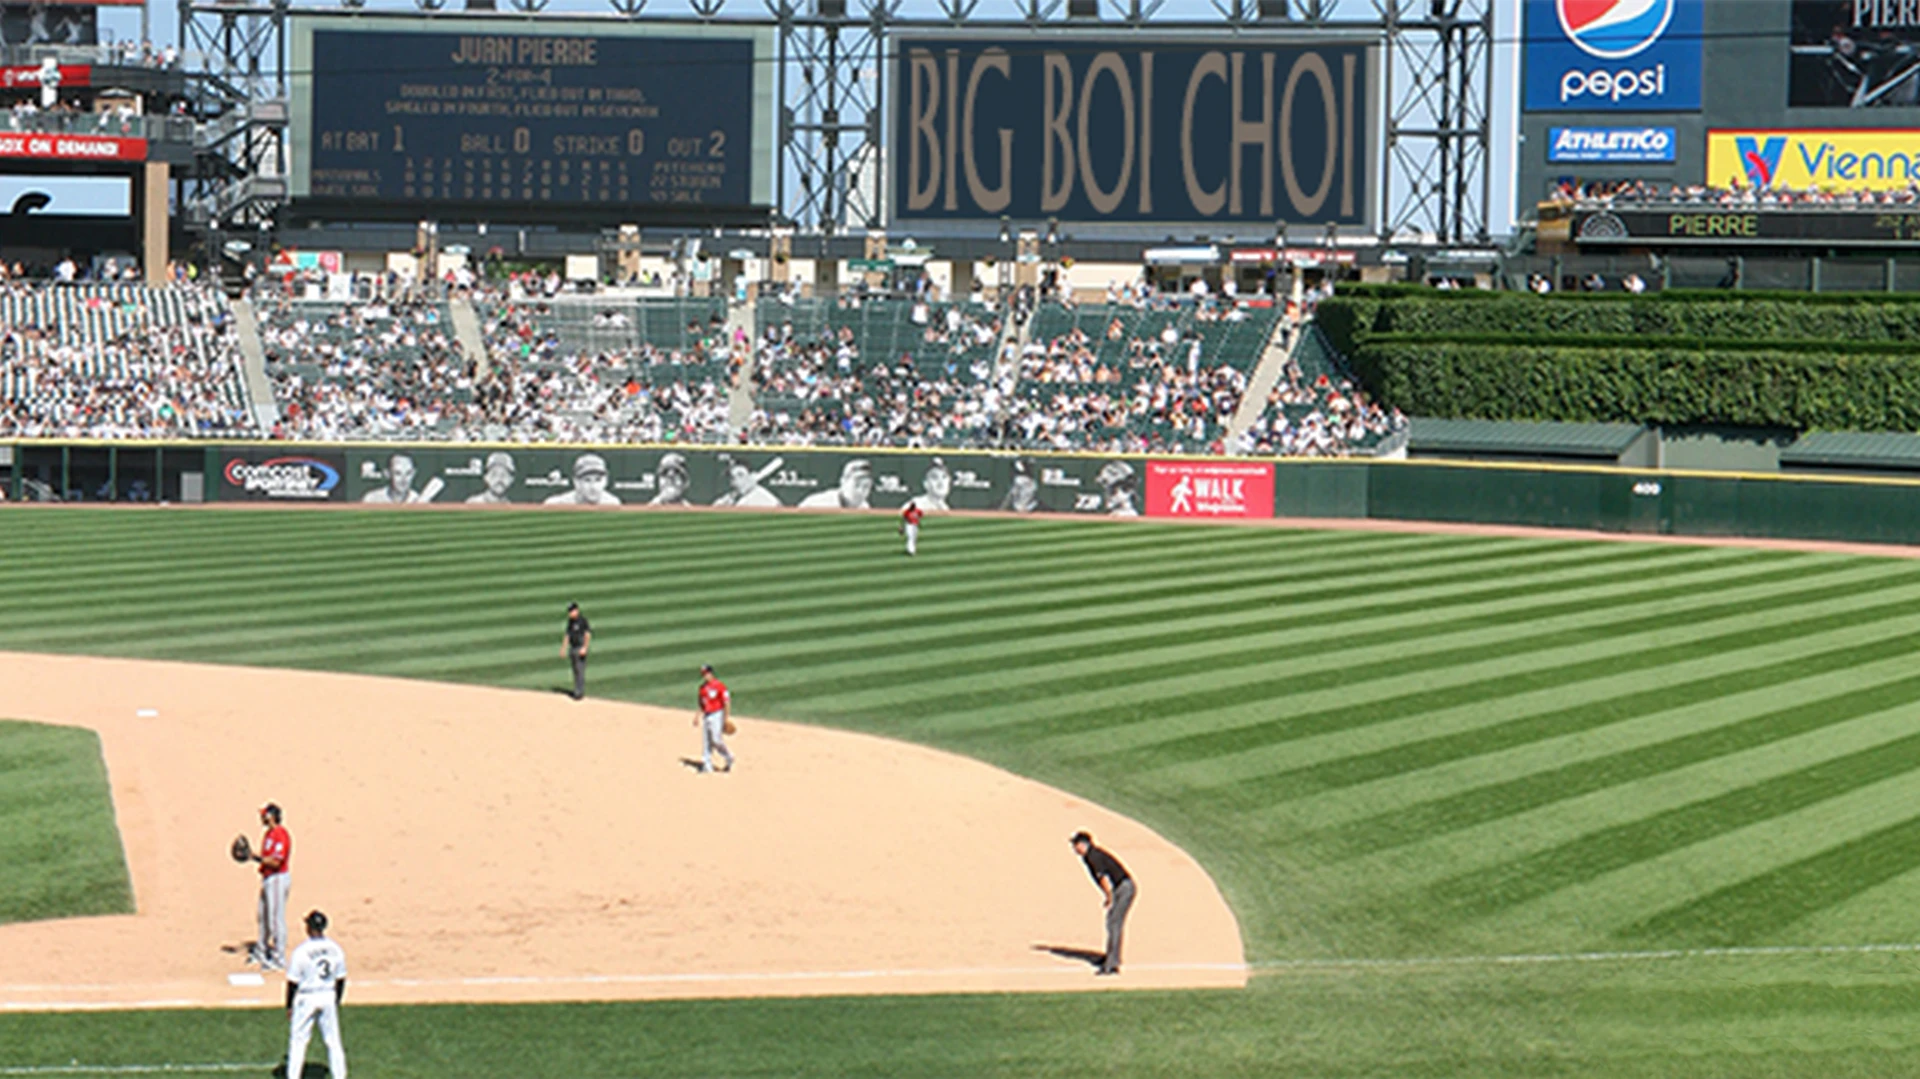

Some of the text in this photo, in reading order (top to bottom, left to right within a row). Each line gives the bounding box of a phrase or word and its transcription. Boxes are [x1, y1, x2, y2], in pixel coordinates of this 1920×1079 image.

[1853, 0, 1920, 27] PIER
[451, 36, 597, 66] JUAN PIERRE
[1560, 63, 1665, 103] pepsi
[321, 124, 727, 157] AT BAT 1 BALL 0 STRIKE 0 OUT 2
[907, 46, 1357, 217] BIG BOI CHOI
[29, 139, 51, 154] ON
[1668, 213, 1758, 236] PIERRE
[1194, 478, 1245, 500] WALK
[316, 958, 331, 981] 3
